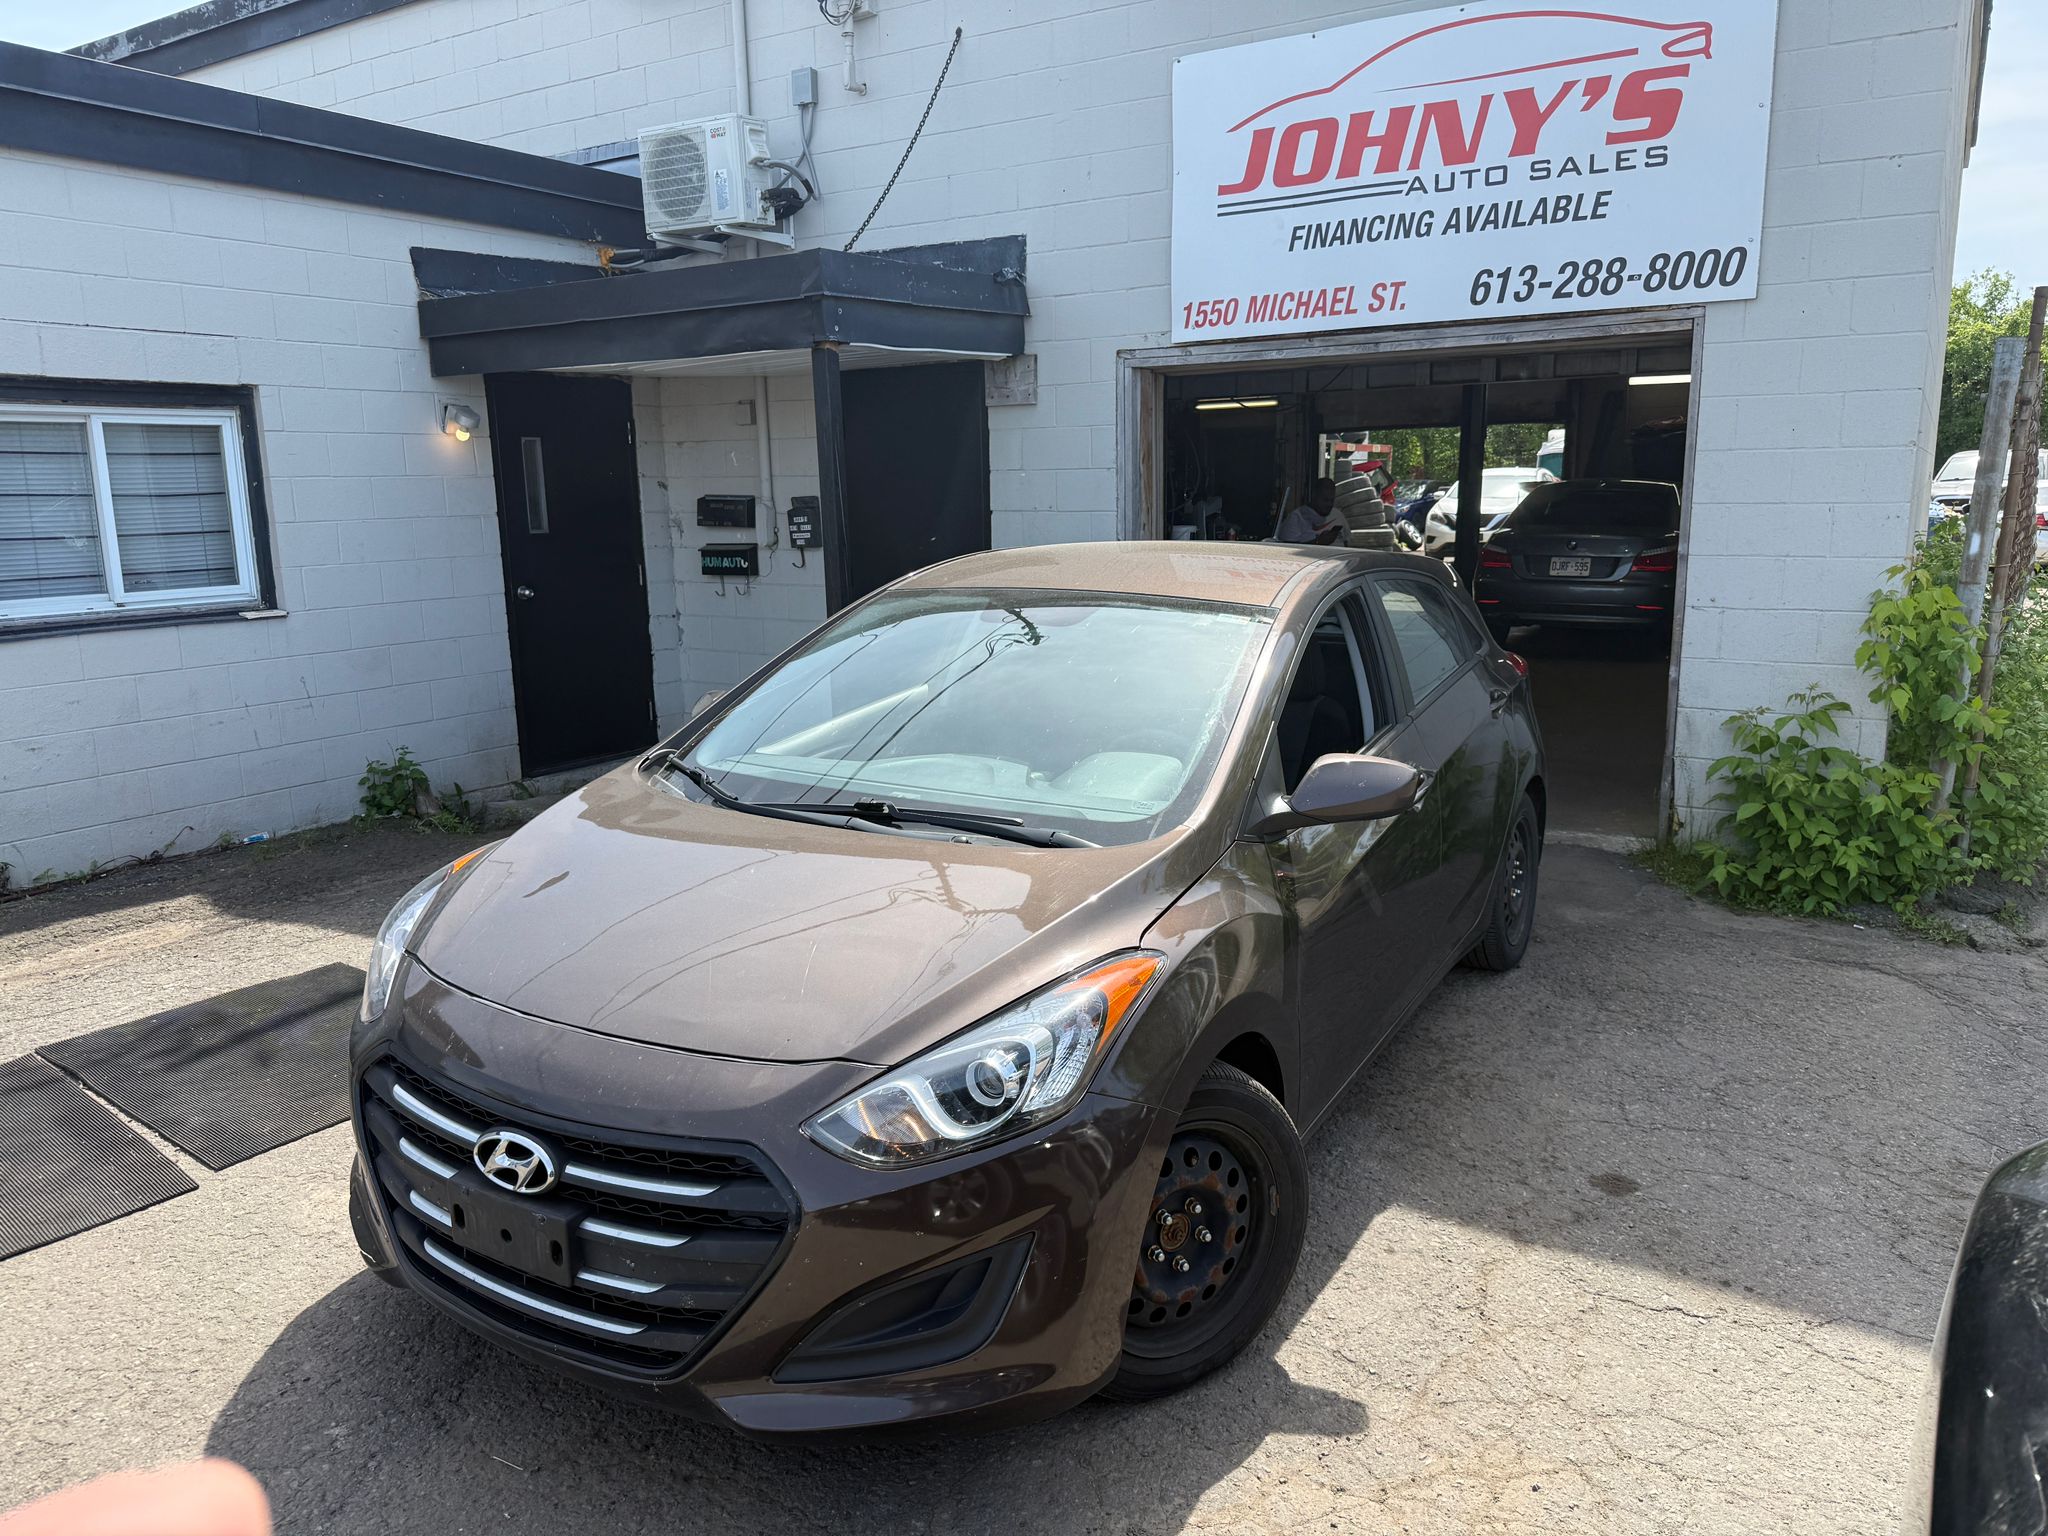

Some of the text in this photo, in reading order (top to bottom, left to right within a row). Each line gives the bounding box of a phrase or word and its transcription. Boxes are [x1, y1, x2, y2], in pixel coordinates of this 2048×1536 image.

[1217, 63, 1691, 196] JOHNY'S
[1404, 145, 1669, 197] AUTO SALES
[1288, 190, 1613, 252] FINANCING AVAILABLE
[1182, 281, 1406, 330] 1550 MICHAEL ST.
[1469, 246, 1748, 306] 613-288-8000
